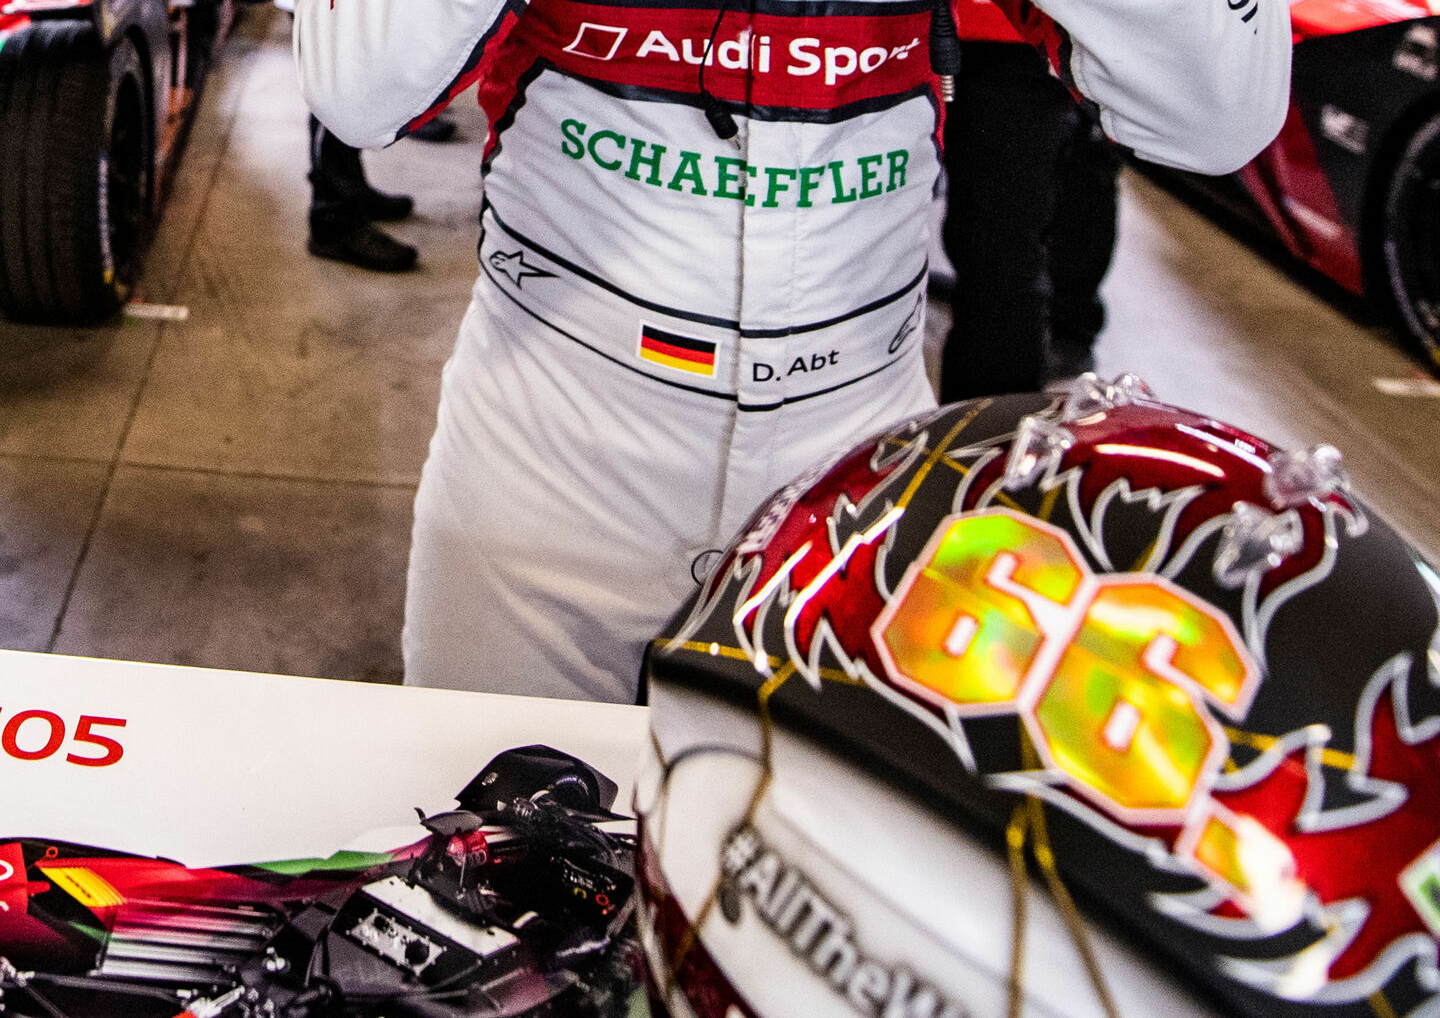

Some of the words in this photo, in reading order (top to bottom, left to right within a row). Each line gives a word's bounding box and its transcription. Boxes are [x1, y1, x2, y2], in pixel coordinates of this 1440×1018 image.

[635, 28, 772, 75] Audi
[559, 117, 911, 209] SCHAEFFLER
[752, 362, 782, 383] D.
[786, 348, 841, 377] Abt
